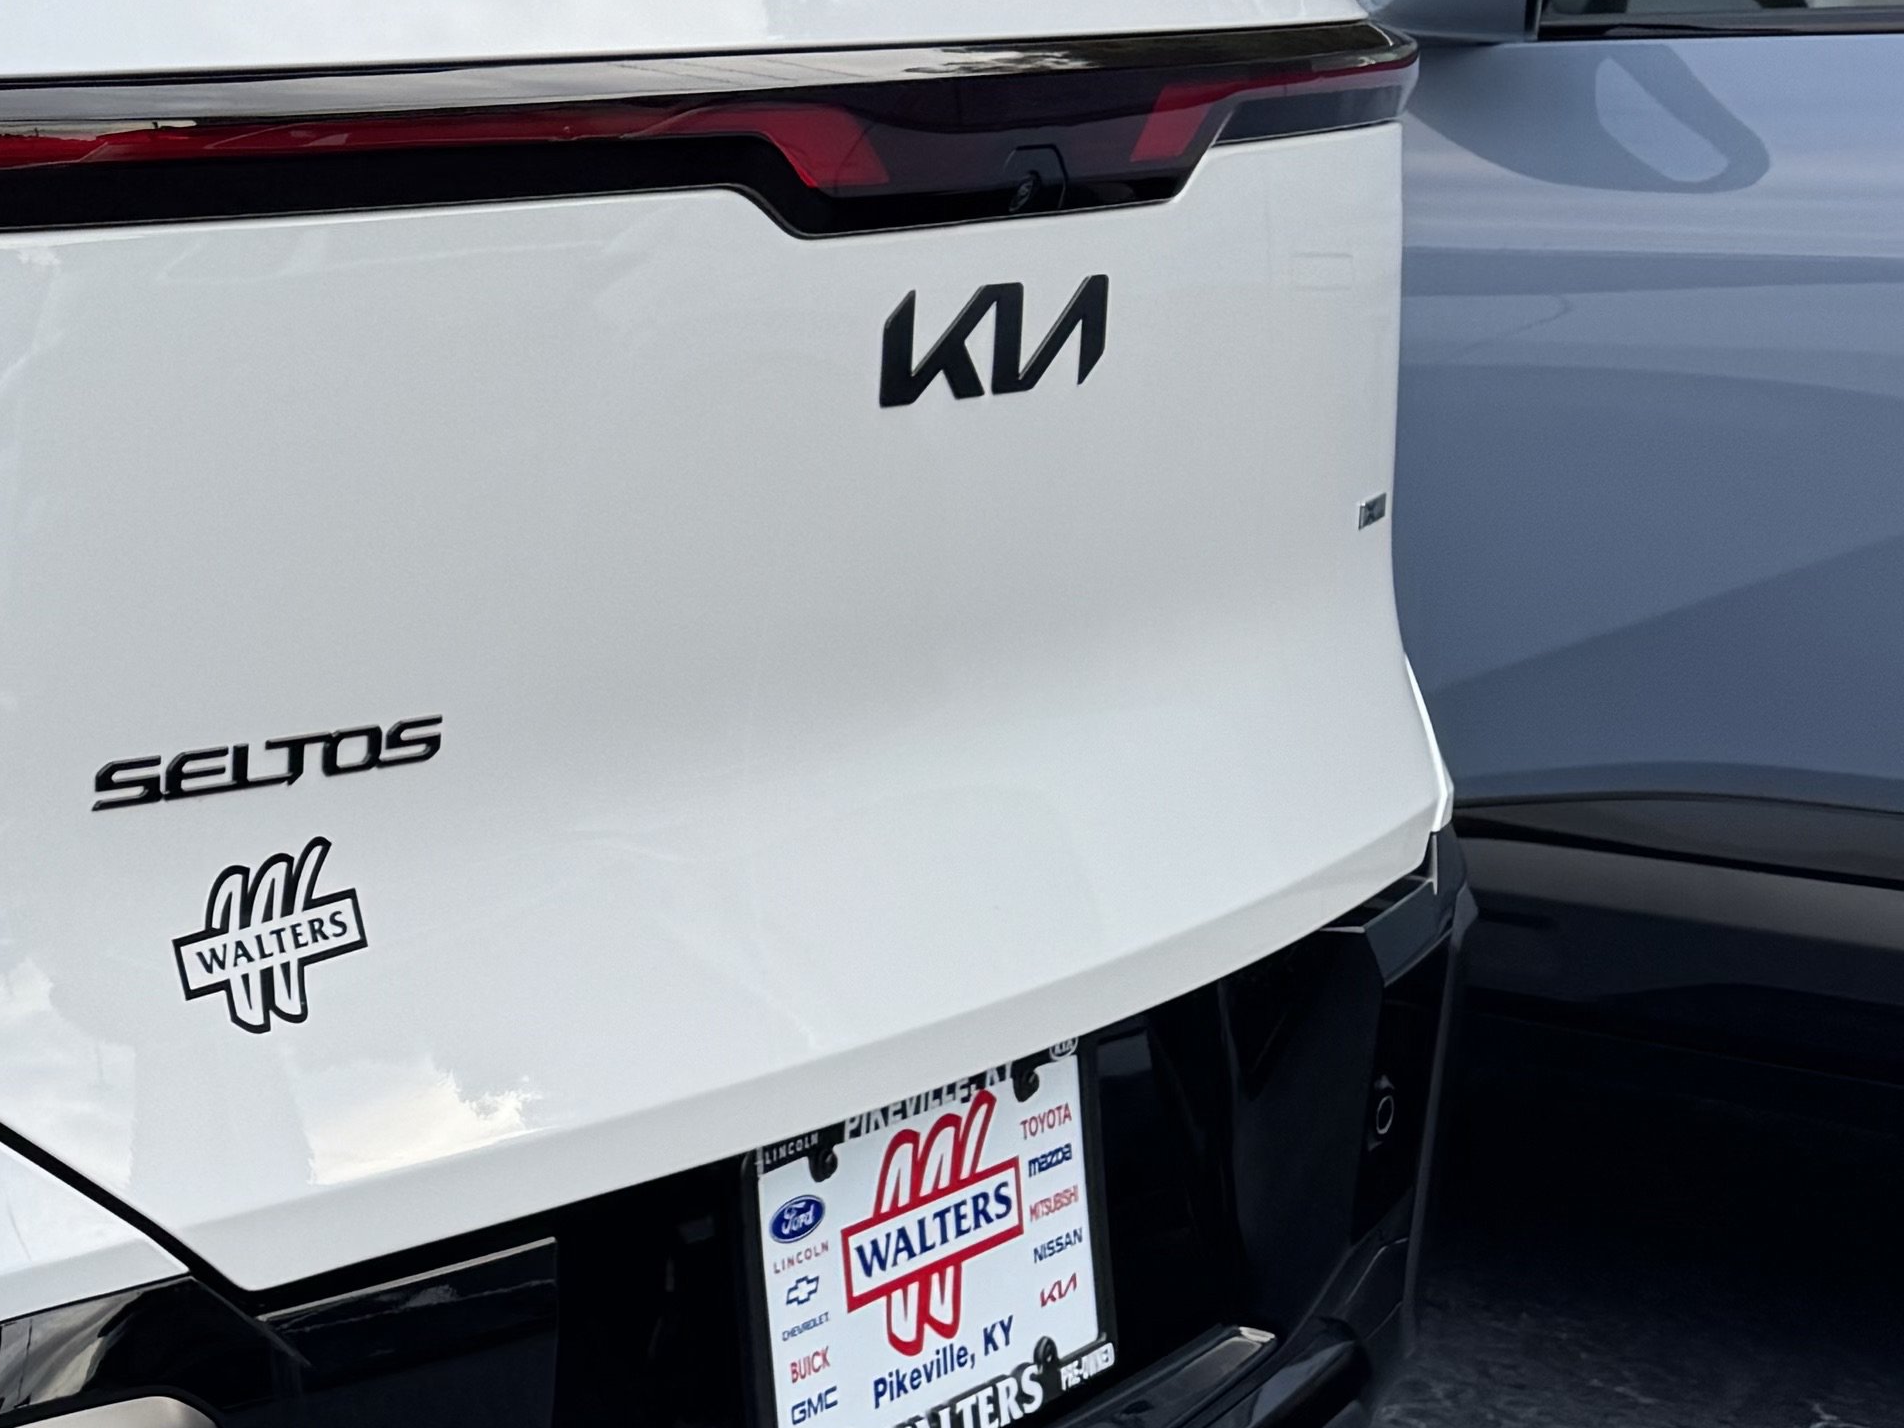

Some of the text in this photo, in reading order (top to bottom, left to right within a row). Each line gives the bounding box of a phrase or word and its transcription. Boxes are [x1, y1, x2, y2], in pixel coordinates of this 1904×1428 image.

[879, 274, 1109, 408] KIA
[92, 714, 443, 812] SELTOS
[195, 909, 348, 974] WALTERS
[1020, 1102, 1072, 1141] TOYOTA
[763, 1132, 819, 1165] LINCOLN
[1028, 1143, 1073, 1178] mazda
[778, 1199, 818, 1238] Ford
[1029, 1184, 1079, 1223] MITSUBISHI
[854, 1180, 1014, 1279] WALTERS
[1033, 1227, 1084, 1264] NISSAN
[773, 1241, 829, 1274] LINCOLN
[1039, 1272, 1078, 1307] KIA
[781, 1311, 830, 1342] CHEVROLET
[790, 1345, 831, 1384] BUICK
[873, 1315, 1014, 1409] Pikeville, KY
[791, 1385, 839, 1425] GMC
